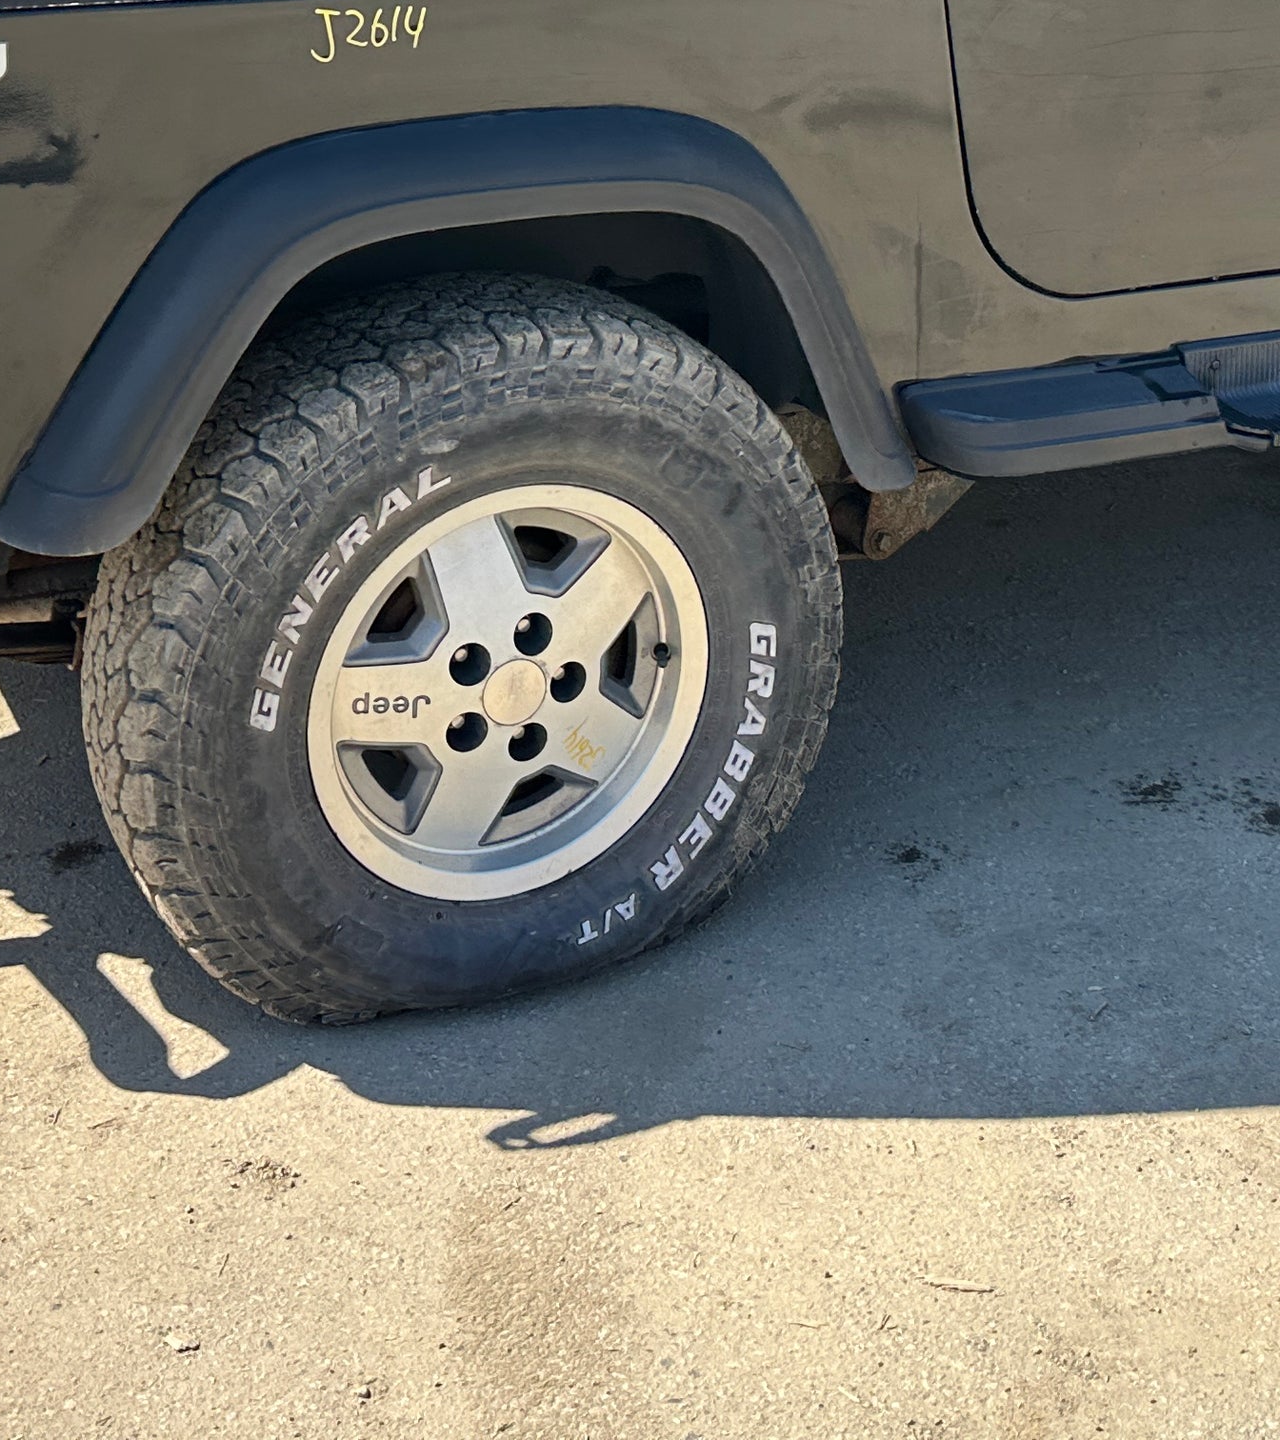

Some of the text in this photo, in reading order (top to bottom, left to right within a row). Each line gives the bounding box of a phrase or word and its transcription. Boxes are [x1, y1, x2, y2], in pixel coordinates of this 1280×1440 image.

[310, 5, 427, 63] J2614
[249, 466, 452, 732] GENERAL
[352, 692, 431, 718] Jeep
[577, 621, 777, 945] GRABBER A/T
